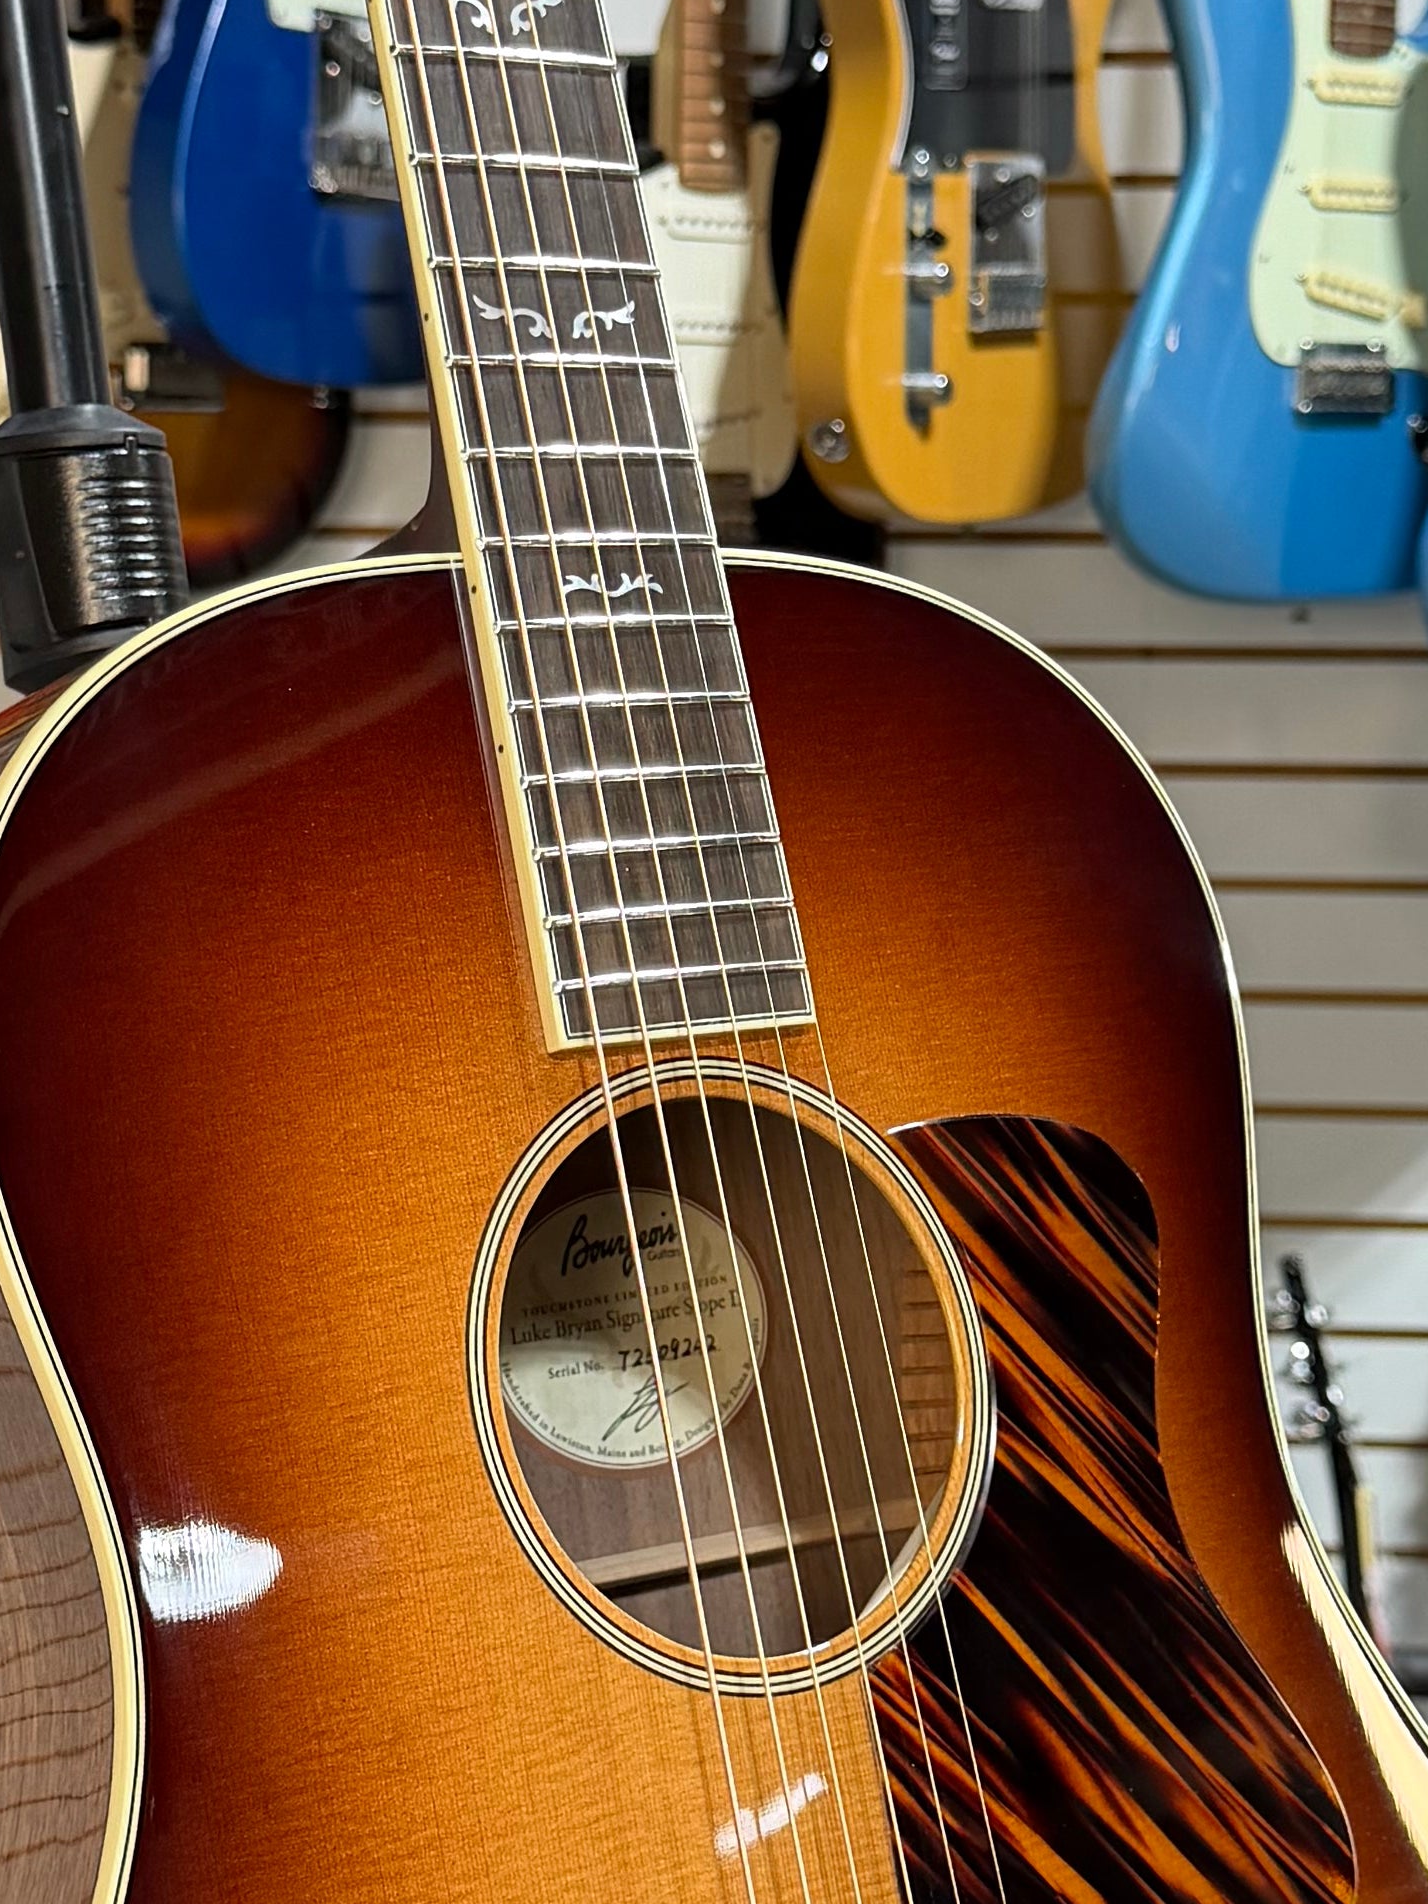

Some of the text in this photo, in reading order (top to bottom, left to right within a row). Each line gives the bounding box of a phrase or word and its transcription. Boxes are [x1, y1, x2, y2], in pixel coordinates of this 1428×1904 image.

[511, 1322, 551, 1346] Luke
[555, 1315, 603, 1342] Bryan
[548, 1361, 581, 1381] Serial
[584, 1359, 605, 1372] No.
[629, 1445, 647, 1458] and
